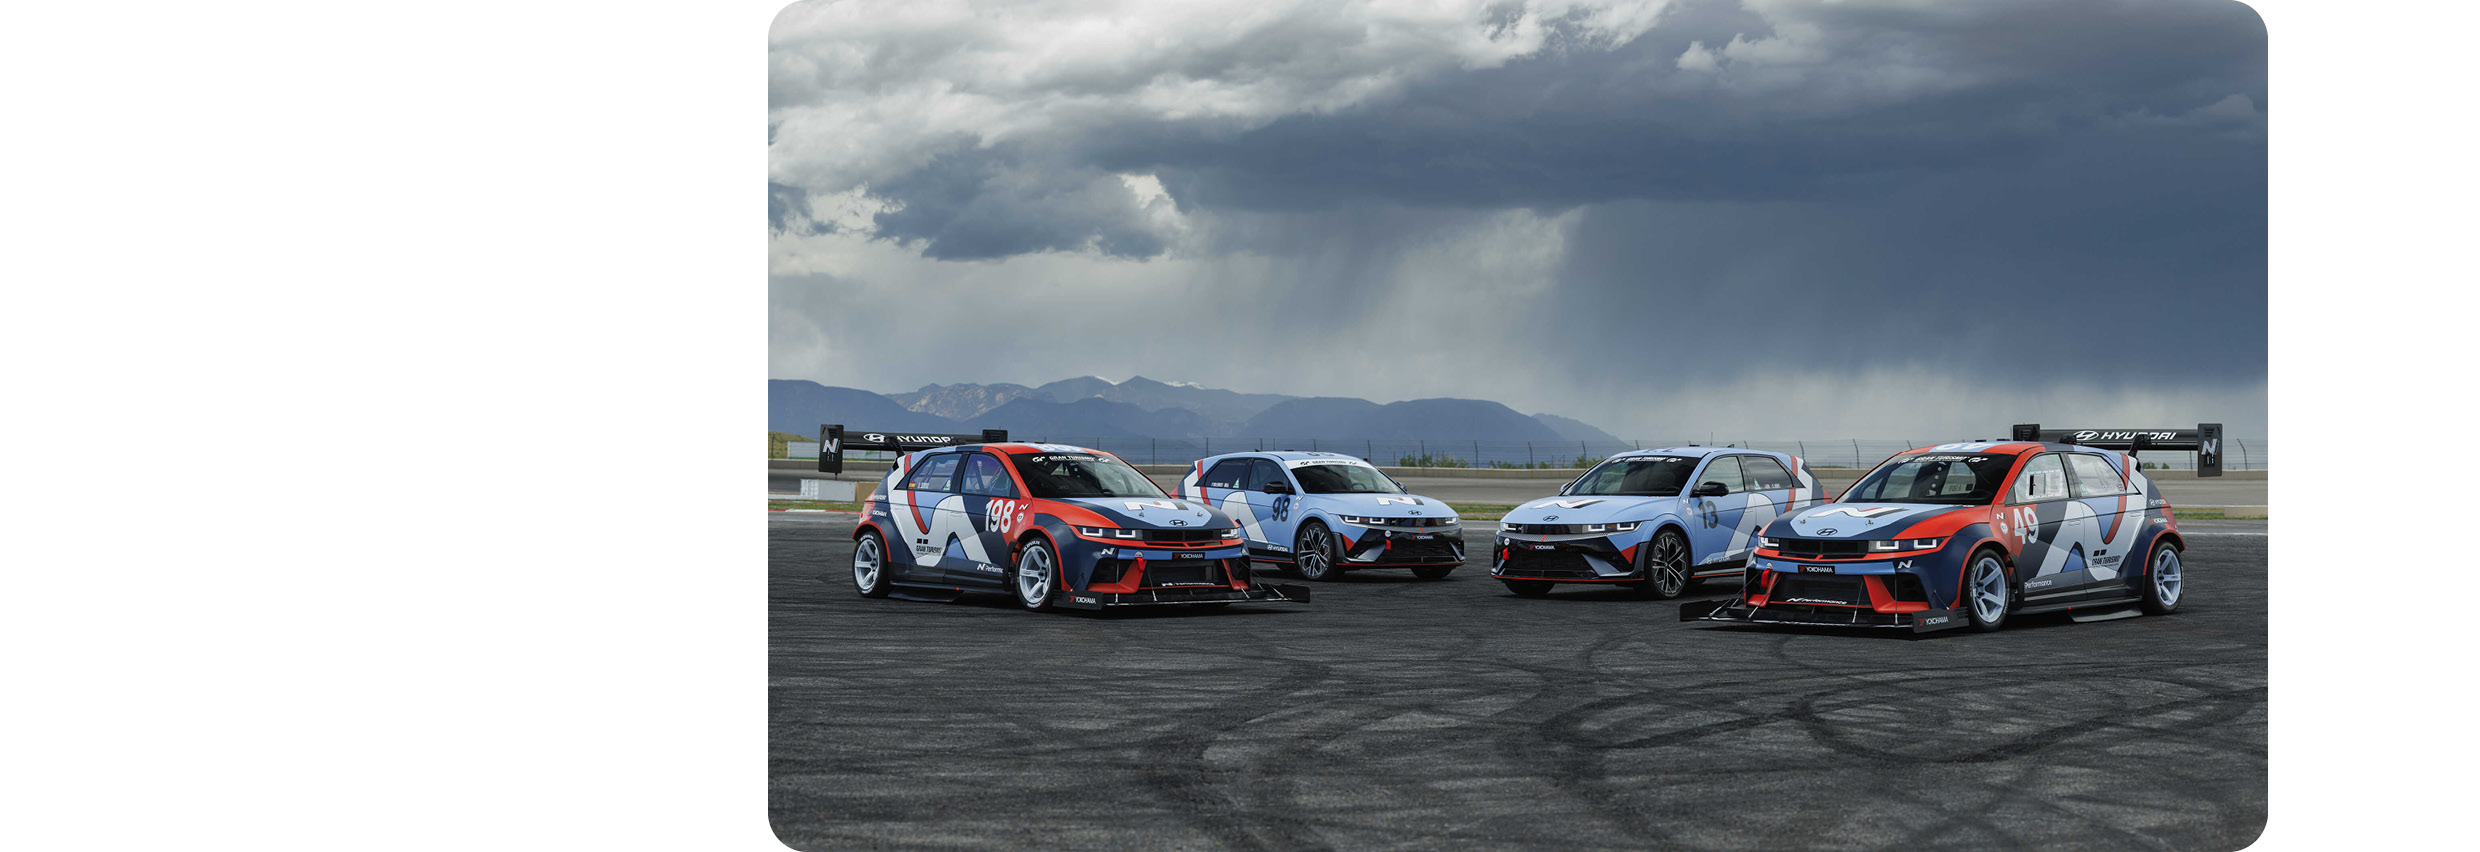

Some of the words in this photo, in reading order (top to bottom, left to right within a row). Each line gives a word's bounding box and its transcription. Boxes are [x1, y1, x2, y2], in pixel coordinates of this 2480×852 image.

[985, 499, 1016, 534] 198
[1272, 496, 1291, 522] 98
[1698, 500, 1719, 529] 13
[2013, 506, 2040, 544] 49
[2024, 580, 2052, 589] Performance
[1075, 597, 1097, 605] YOKOHAMA
[1925, 616, 1949, 625] YOKOHAMA
